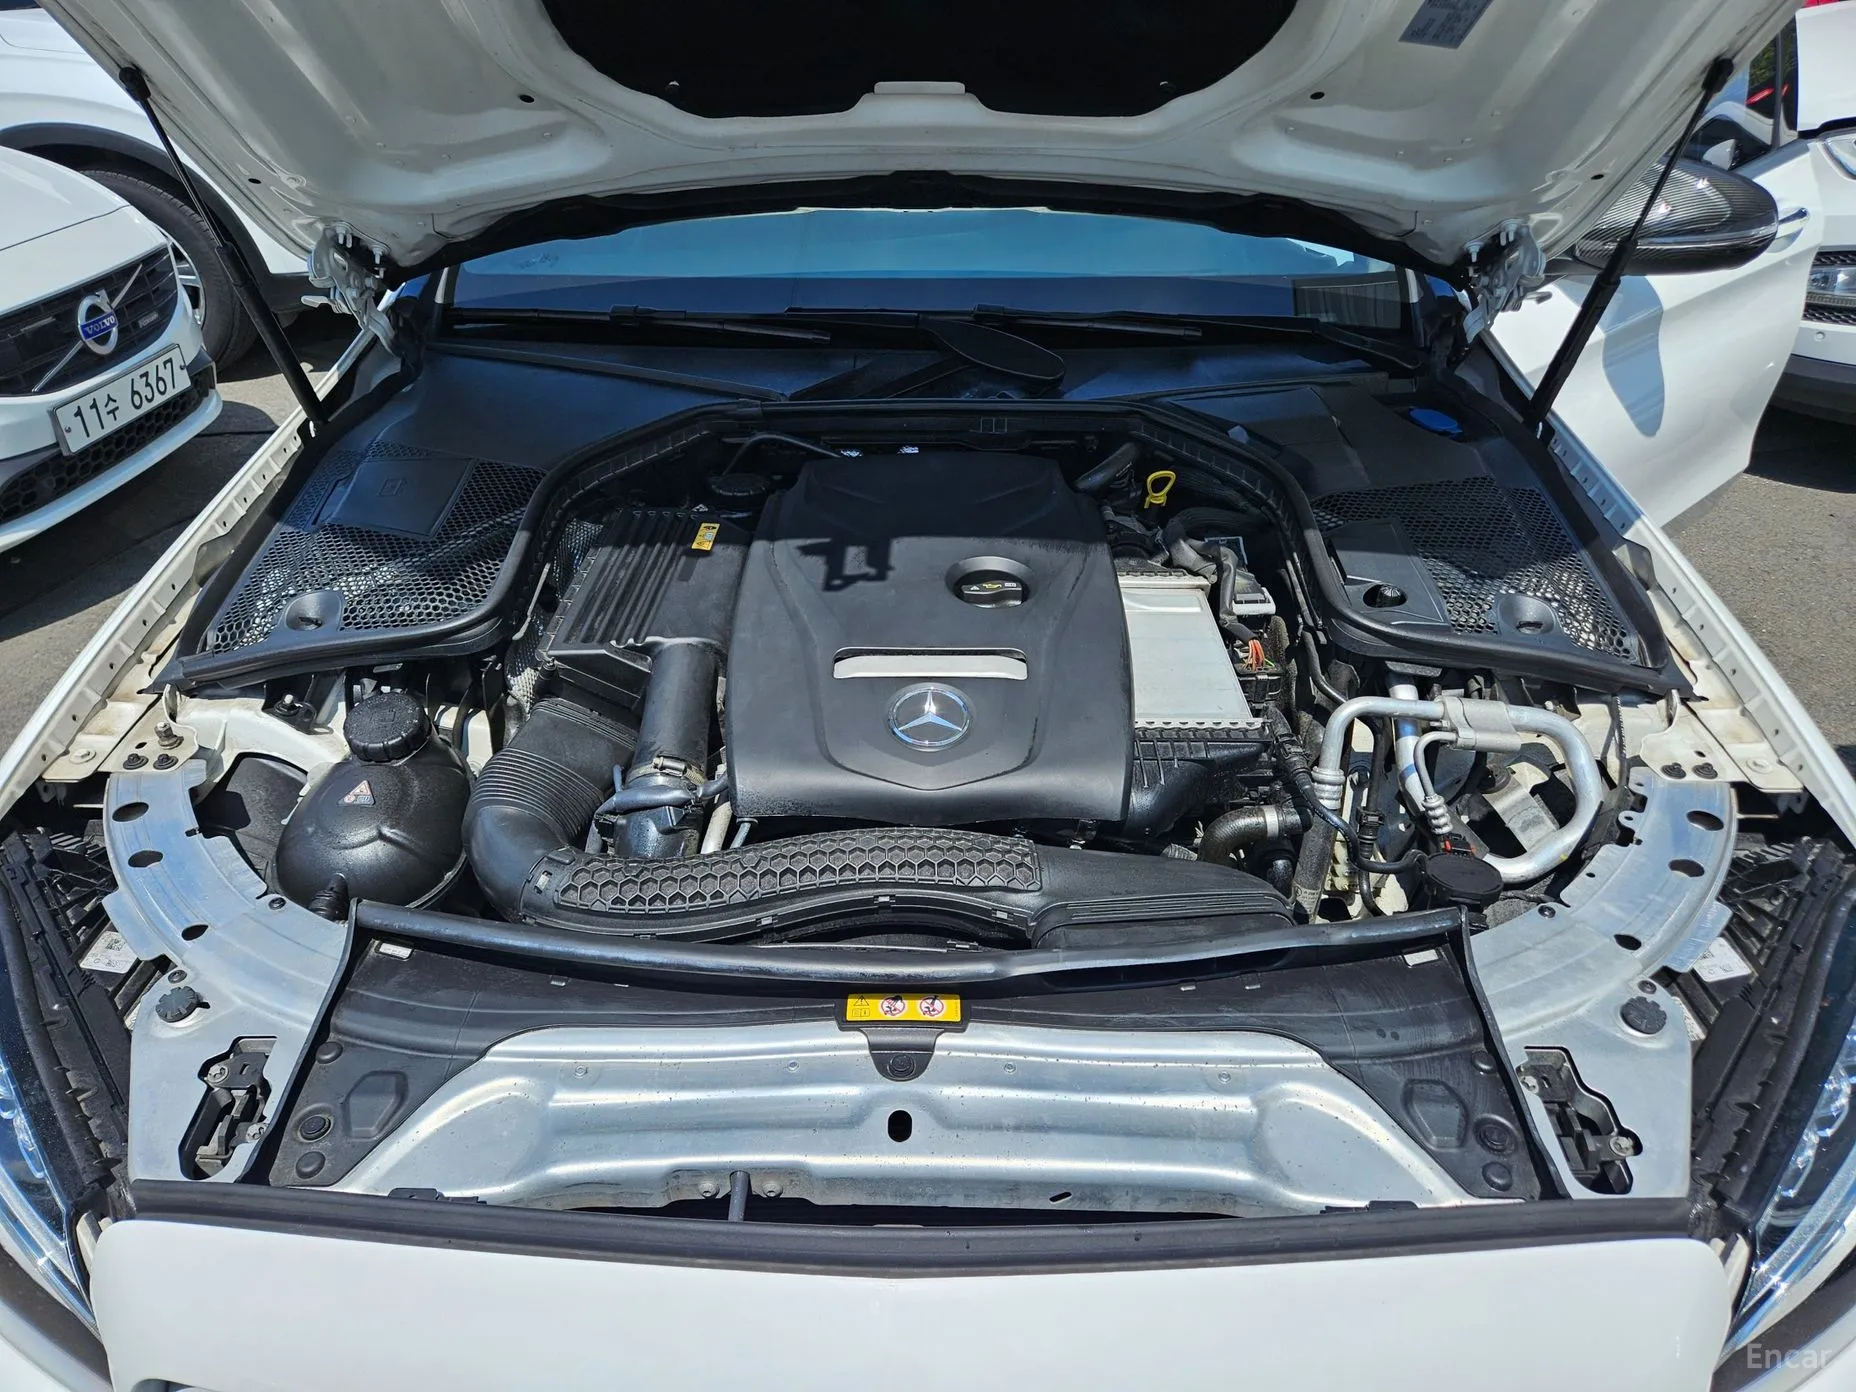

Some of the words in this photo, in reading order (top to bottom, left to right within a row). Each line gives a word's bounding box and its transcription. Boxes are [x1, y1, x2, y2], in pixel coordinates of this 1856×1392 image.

[85, 315, 115, 334] VOLVO
[73, 394, 120, 438] 11수
[129, 357, 176, 410] 6367
